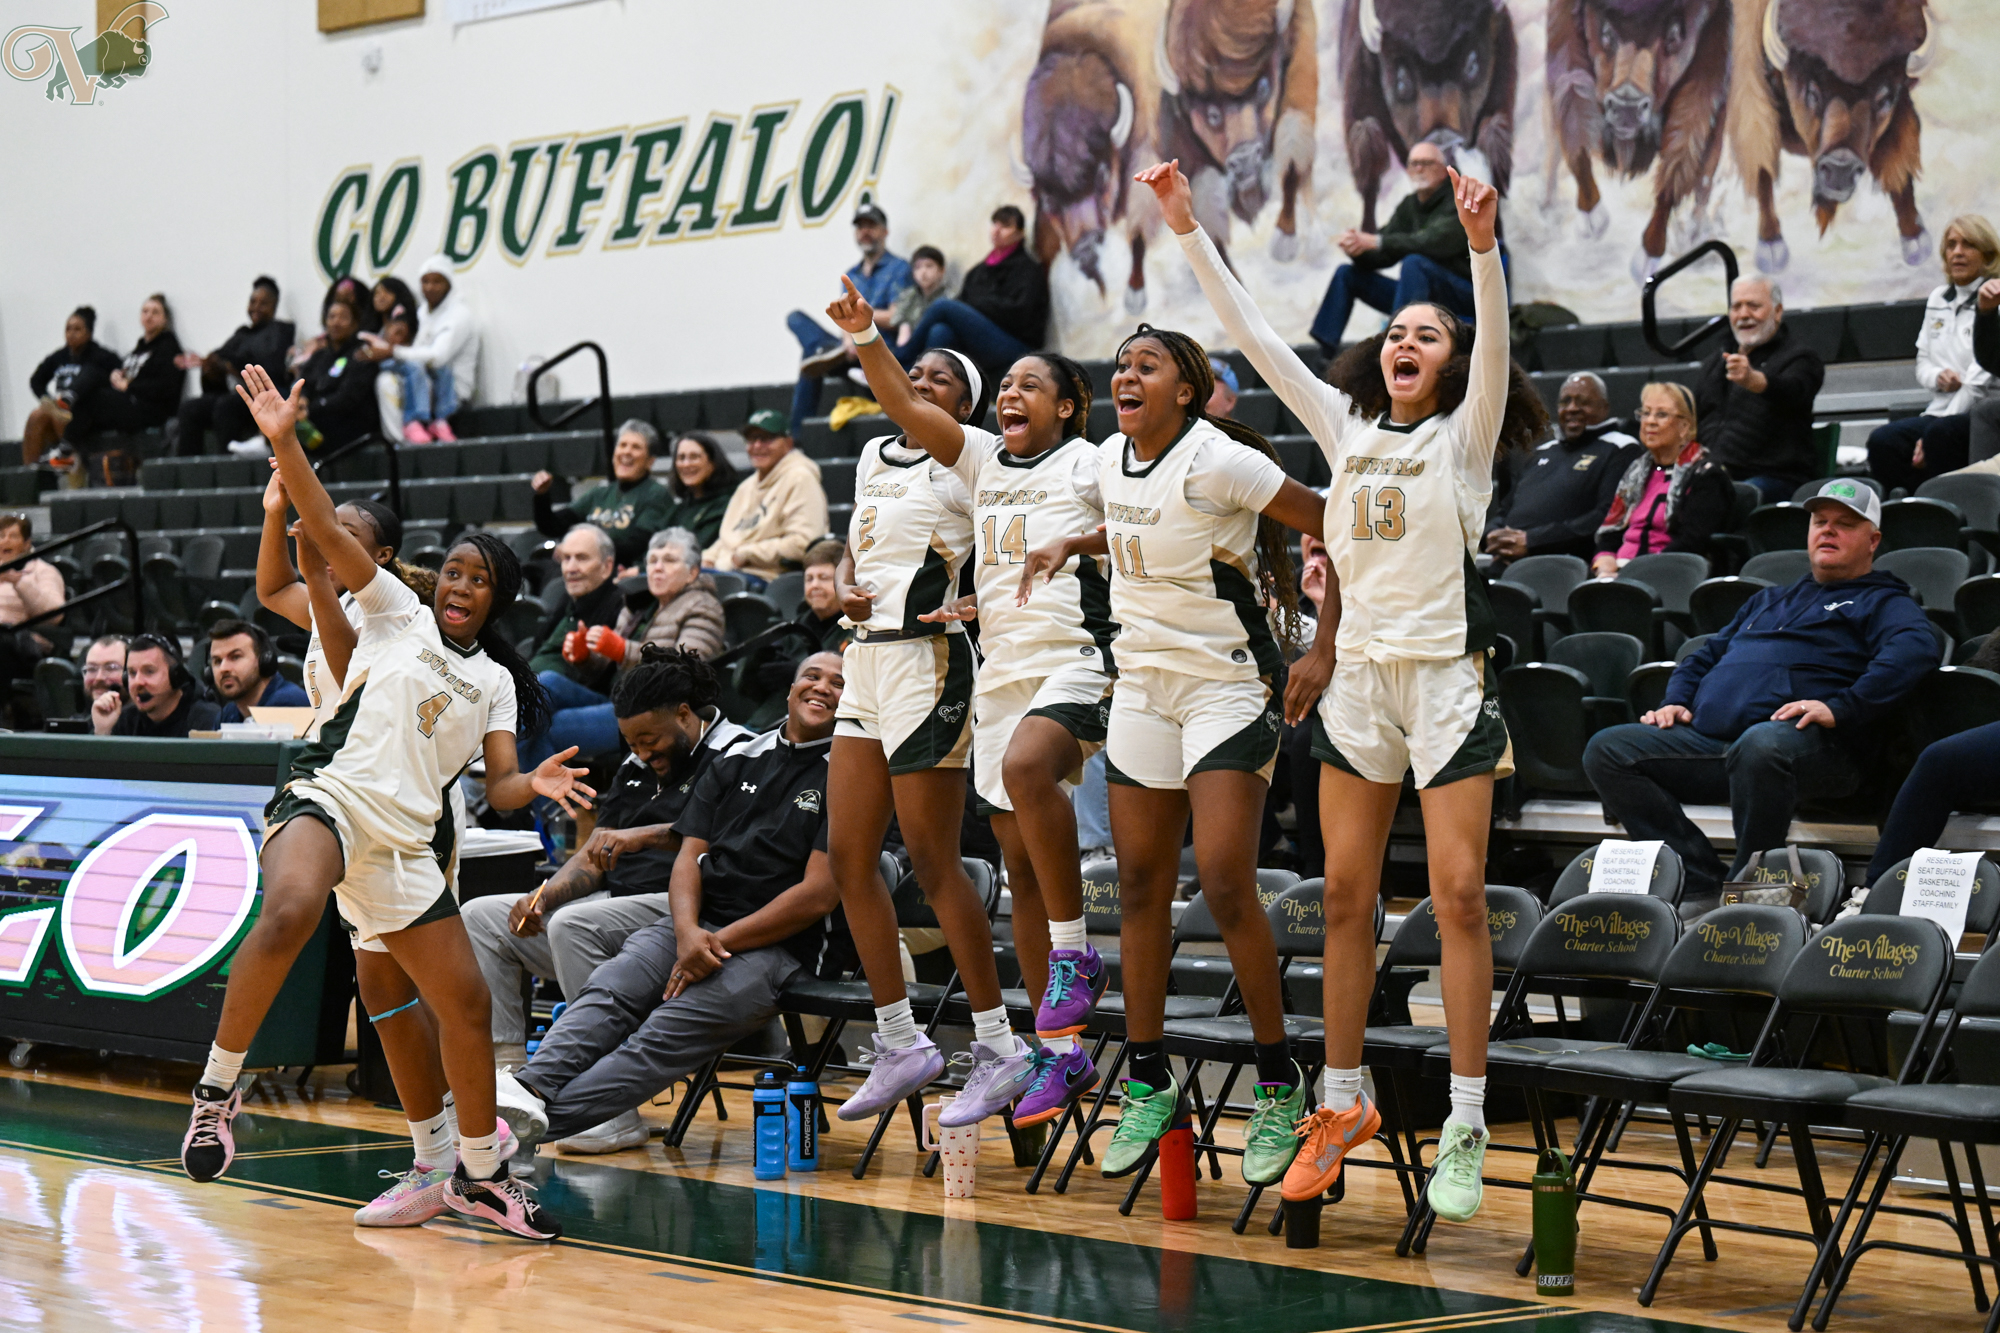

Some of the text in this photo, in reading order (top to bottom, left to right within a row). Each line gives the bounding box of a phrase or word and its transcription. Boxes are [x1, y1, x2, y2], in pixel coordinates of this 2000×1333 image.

[314, 83, 901, 285] GO BUFFALO!
[1344, 455, 1425, 476] BUFFALO
[1352, 485, 1405, 541] 13
[857, 505, 877, 552] 2
[981, 513, 1027, 565] 14
[1111, 532, 1147, 577] 11
[417, 691, 452, 738] 4
[1926, 856, 1962, 864] RESERVED
[1602, 867, 1640, 875] BASKETBALL
[1935, 868, 1966, 876] BUFFALO
[1082, 879, 1102, 901] The
[1603, 877, 1635, 885] COACHING
[1918, 877, 1960, 887] BASKETBALL
[1920, 889, 1956, 897] COACHING
[1083, 902, 1112, 914] Charter
[1281, 898, 1309, 921] The
[1912, 899, 1958, 909] STAFF-FAMILY
[1287, 922, 1320, 935] Charter
[1555, 911, 1653, 940] The Villages
[1564, 938, 1639, 953] Charter School
[1697, 921, 1782, 952] The Villages
[1703, 950, 1768, 965] Charter School
[1821, 934, 1921, 966] The Villages
[1829, 964, 1904, 980] Charter School
